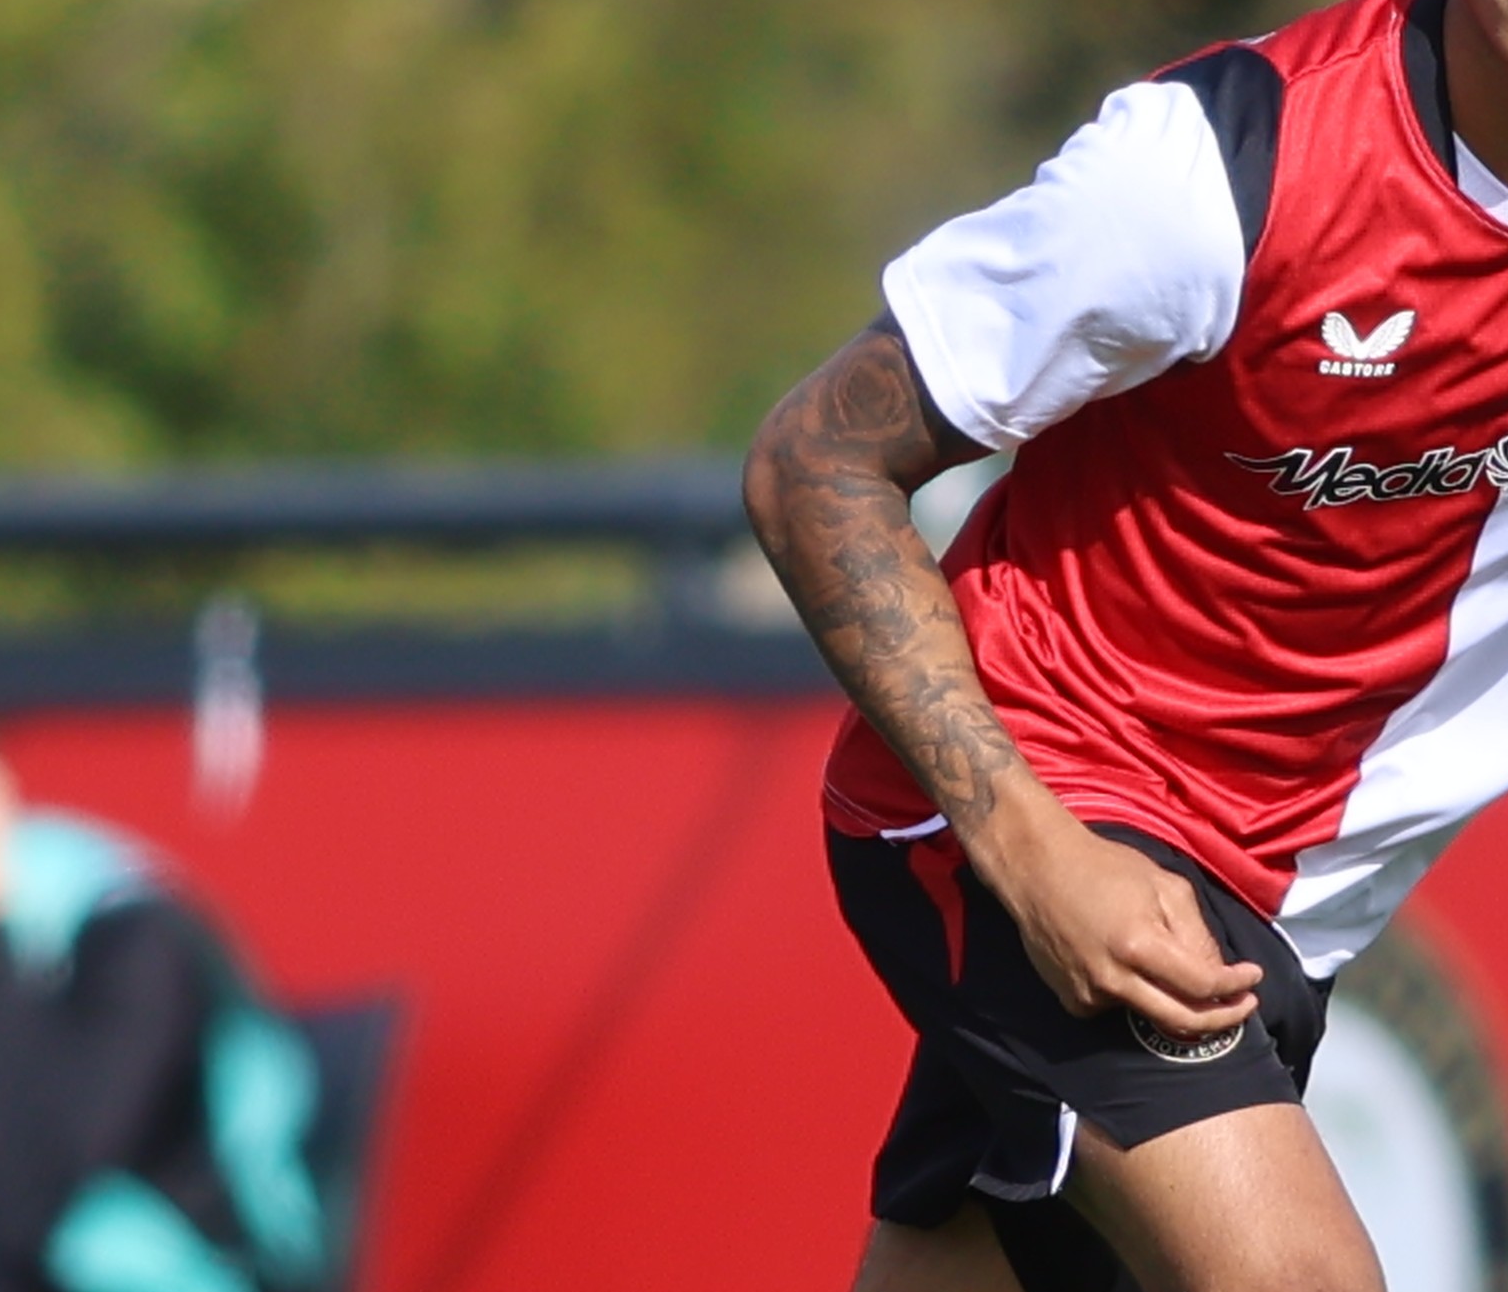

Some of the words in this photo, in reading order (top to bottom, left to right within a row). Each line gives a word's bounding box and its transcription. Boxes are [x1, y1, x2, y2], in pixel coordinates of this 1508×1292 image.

[1318, 360, 1395, 377] CASTORE
[1224, 447, 1488, 510] Media
[1147, 1027, 1239, 1058] ROTTERD
